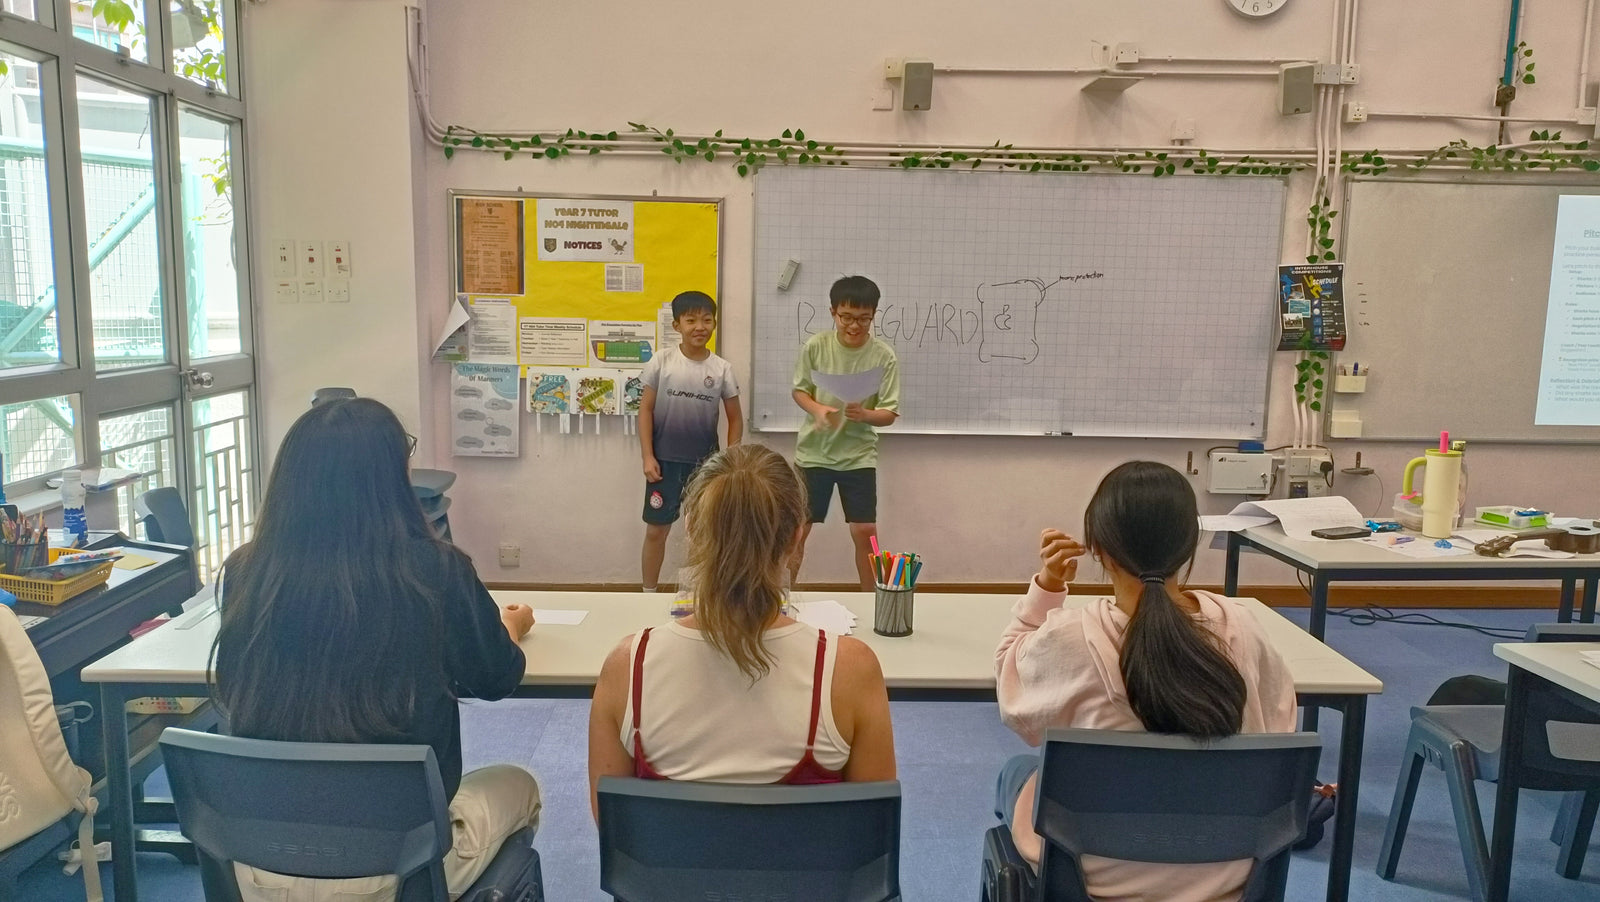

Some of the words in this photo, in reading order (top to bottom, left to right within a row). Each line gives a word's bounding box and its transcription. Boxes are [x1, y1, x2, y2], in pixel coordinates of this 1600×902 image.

[1252, 2, 1259, 13] 6
[580, 207, 587, 217] 7
[588, 208, 619, 217] TUTOR
[563, 240, 603, 250] NOTICES
[543, 375, 564, 383] FREE
[672, 389, 714, 402] UNIHOC
